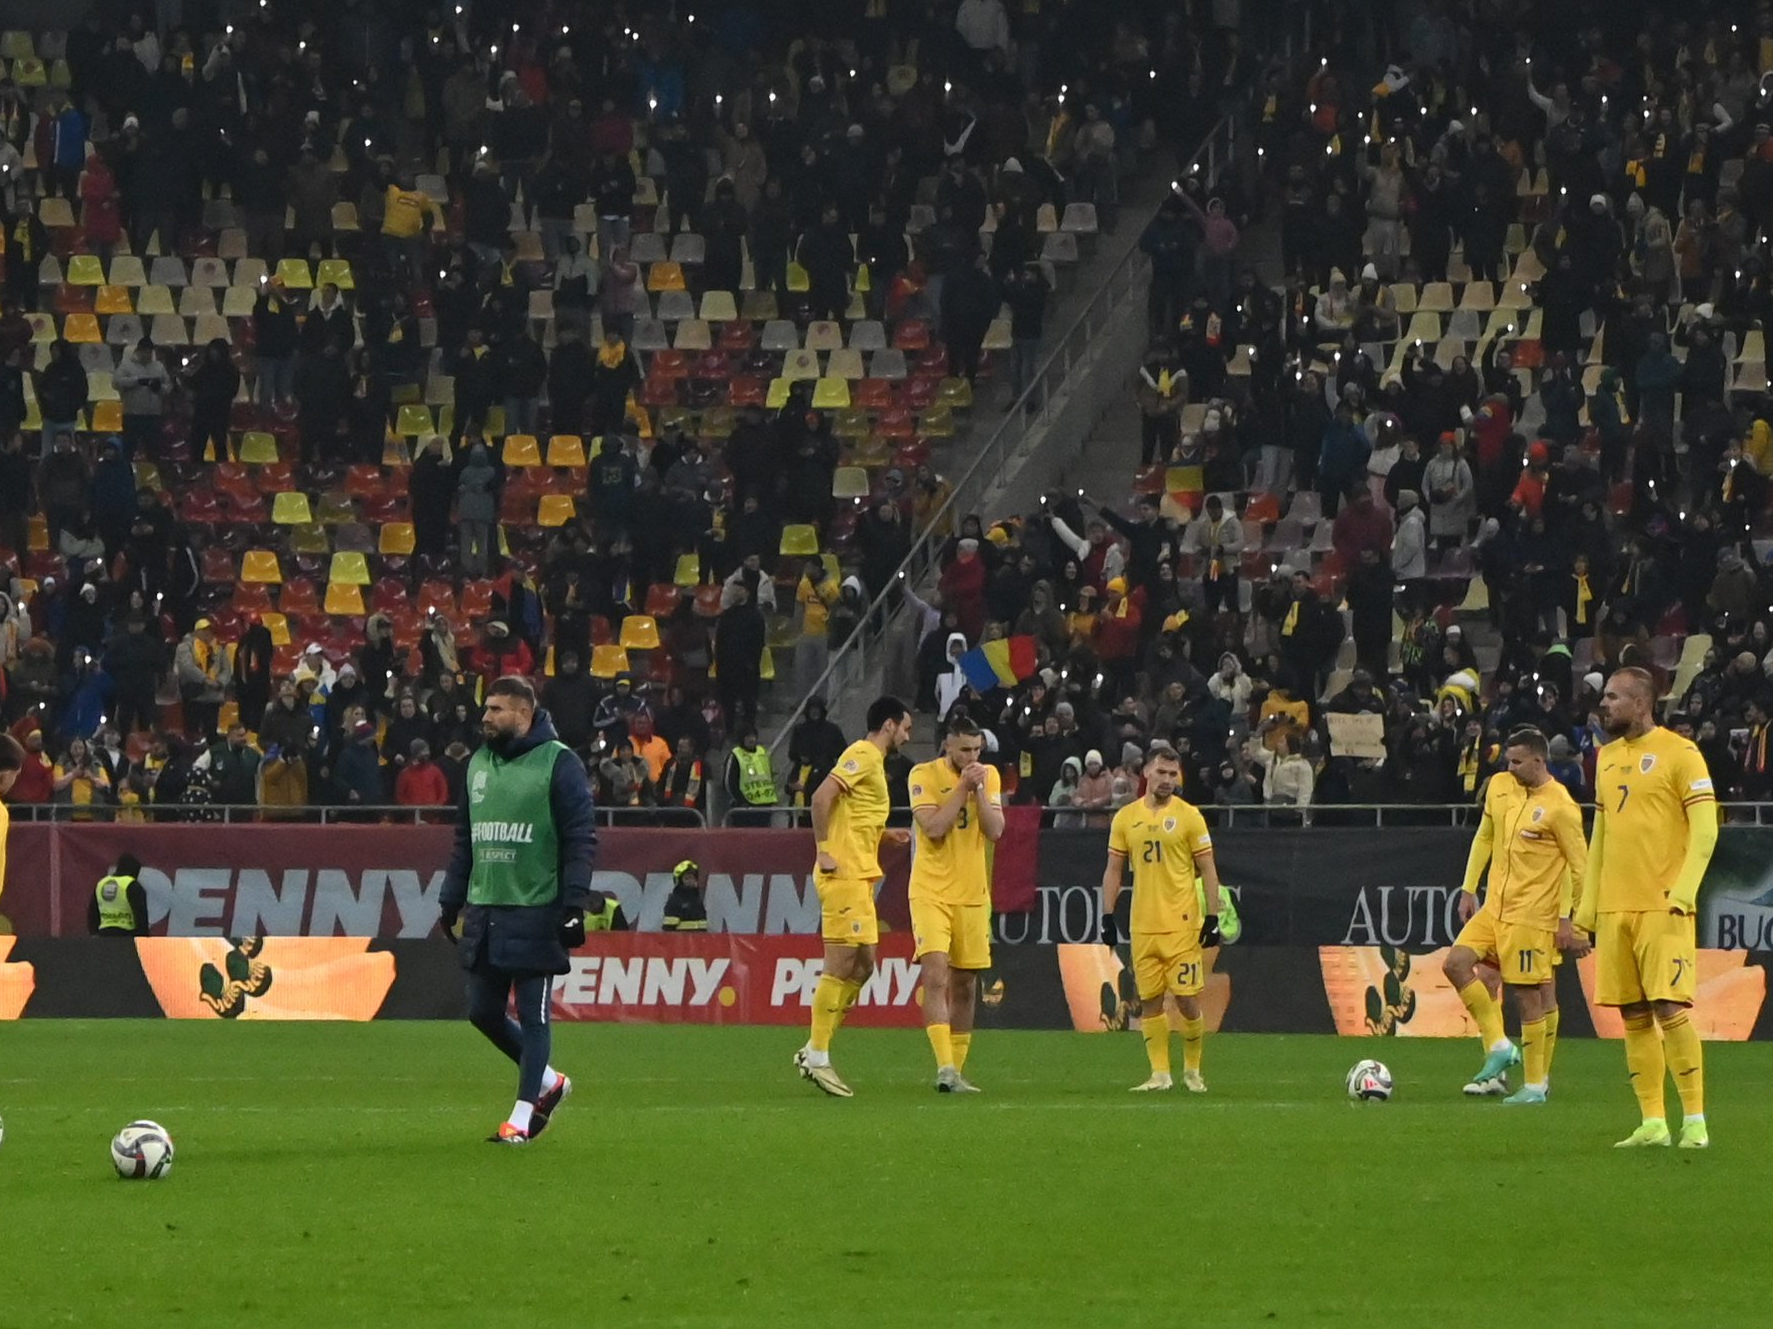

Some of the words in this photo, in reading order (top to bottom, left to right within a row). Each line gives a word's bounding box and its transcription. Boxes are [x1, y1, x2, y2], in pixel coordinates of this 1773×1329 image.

[1617, 785, 1628, 813] 7
[1143, 840, 1161, 863] 21
[1519, 949, 1534, 973] 11
[1671, 959, 1682, 986] 7
[1178, 963, 1196, 985] 21
